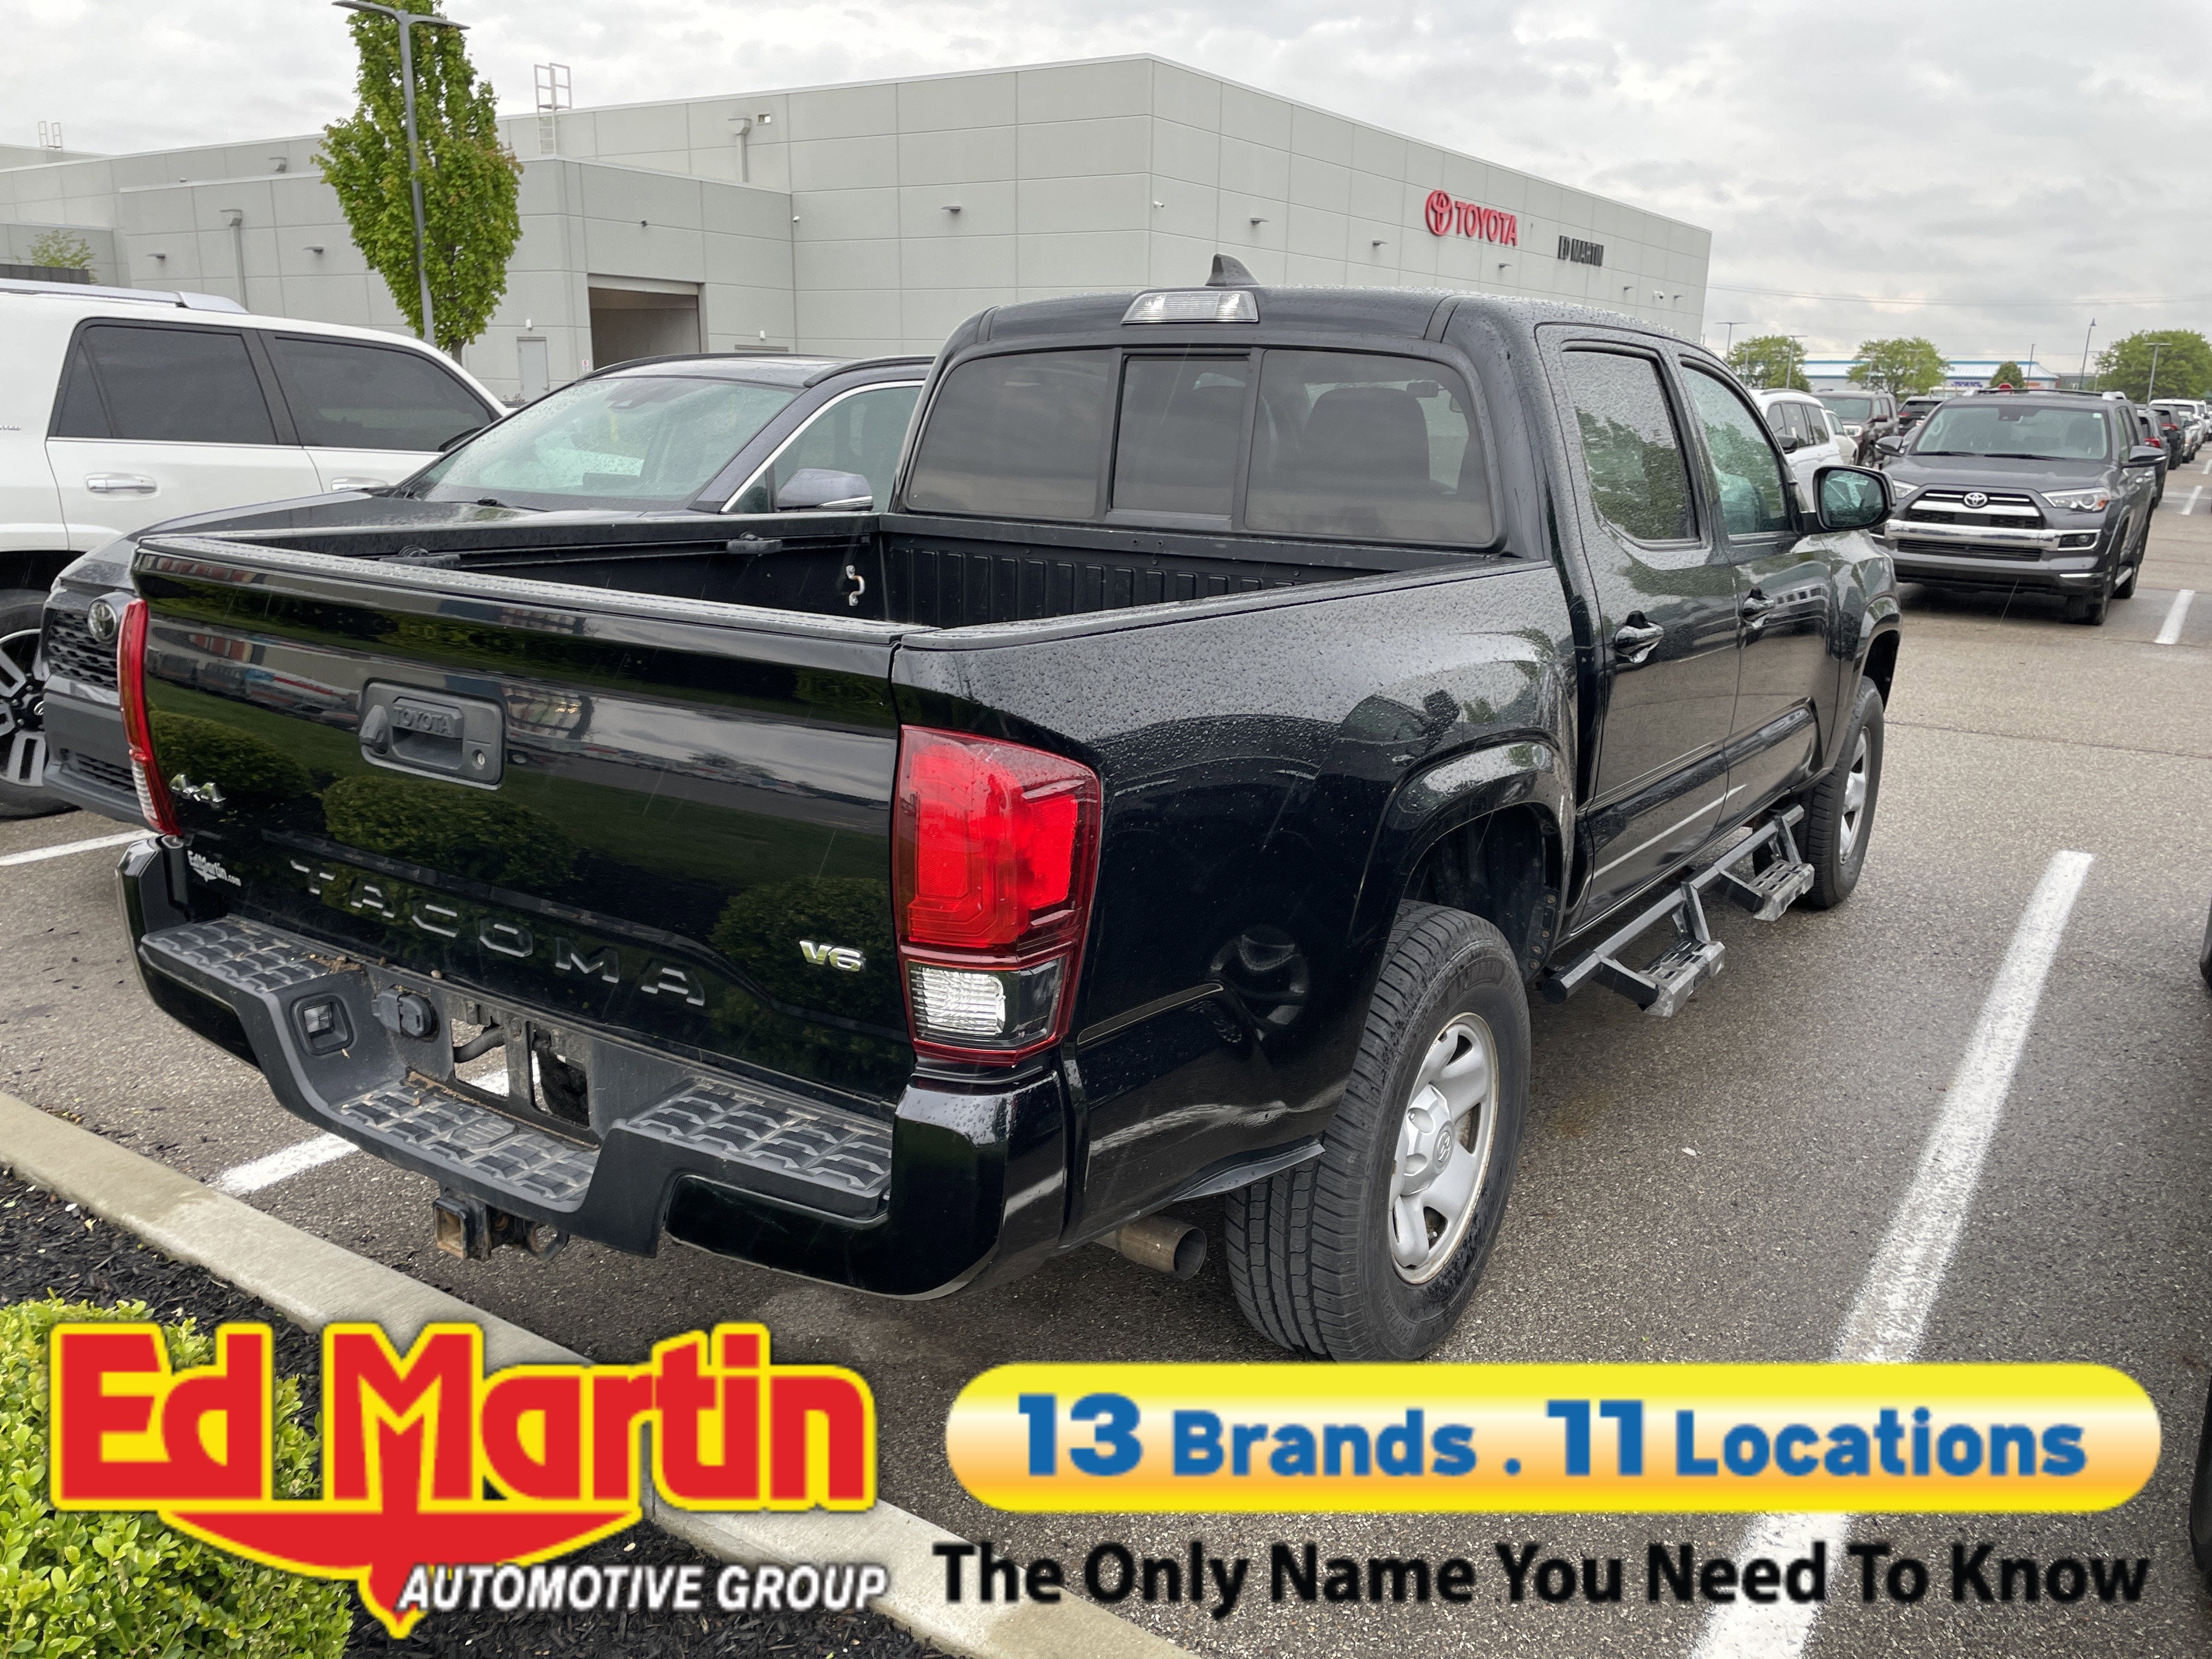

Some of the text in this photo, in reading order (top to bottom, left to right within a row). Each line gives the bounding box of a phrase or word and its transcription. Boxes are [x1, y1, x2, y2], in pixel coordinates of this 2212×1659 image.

[1455, 201, 1518, 246] TOYOTA
[393, 705, 454, 735] TOYOTA
[290, 859, 706, 1006] TACOMA
[799, 939, 864, 972] V6
